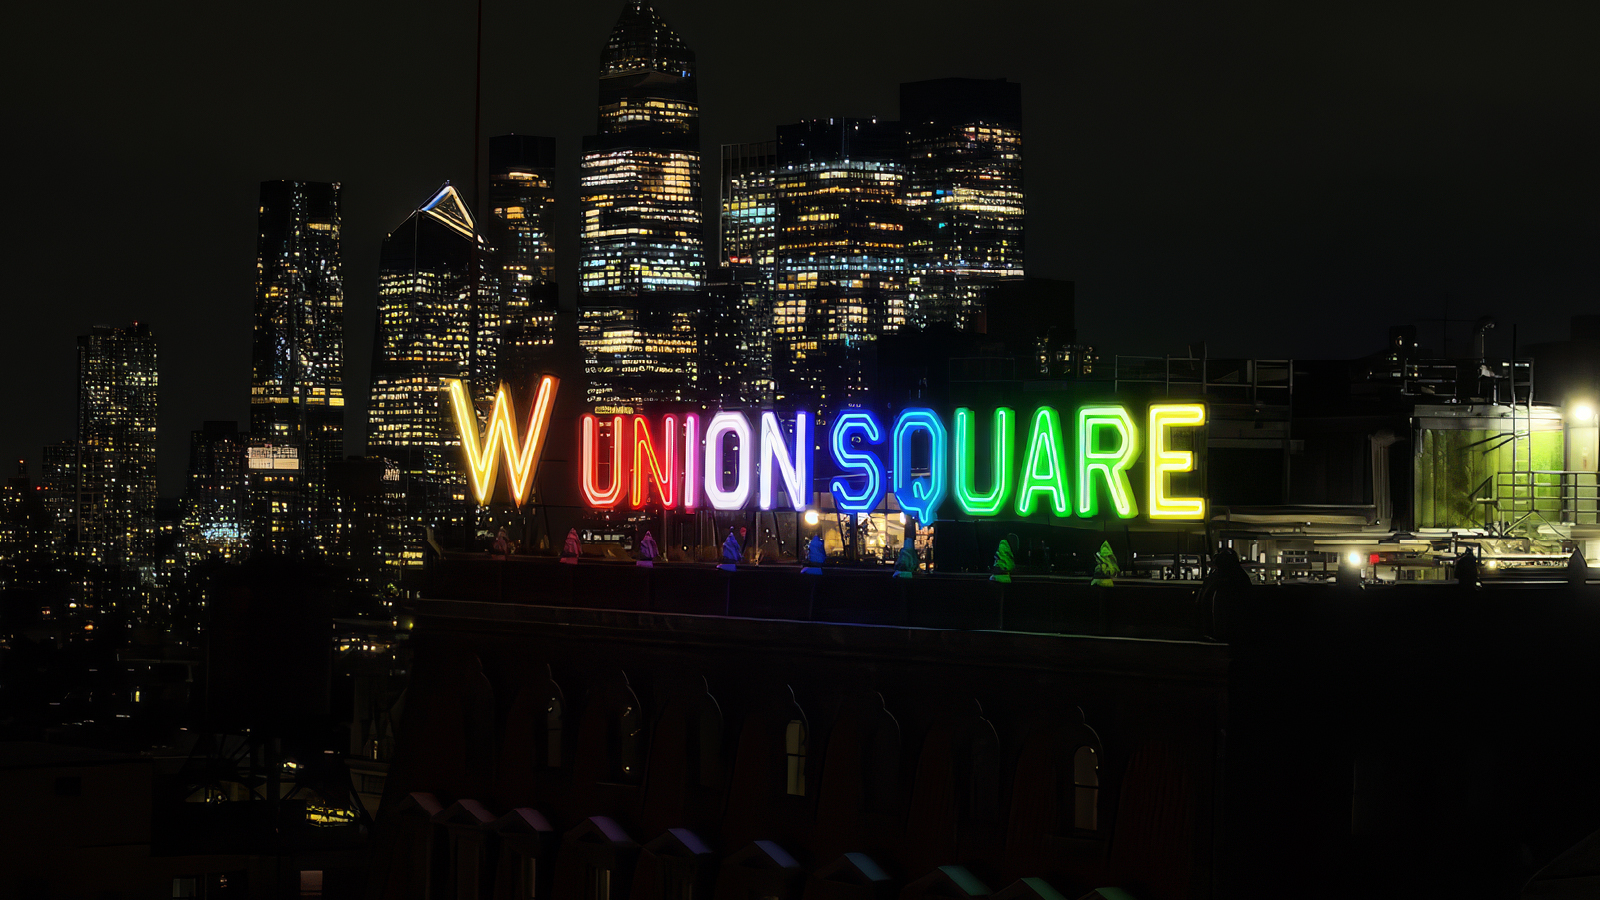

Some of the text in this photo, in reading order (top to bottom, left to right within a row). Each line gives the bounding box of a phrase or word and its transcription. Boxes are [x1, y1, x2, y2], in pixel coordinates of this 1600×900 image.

[449, 374, 1207, 526] W UNION SQUARE
